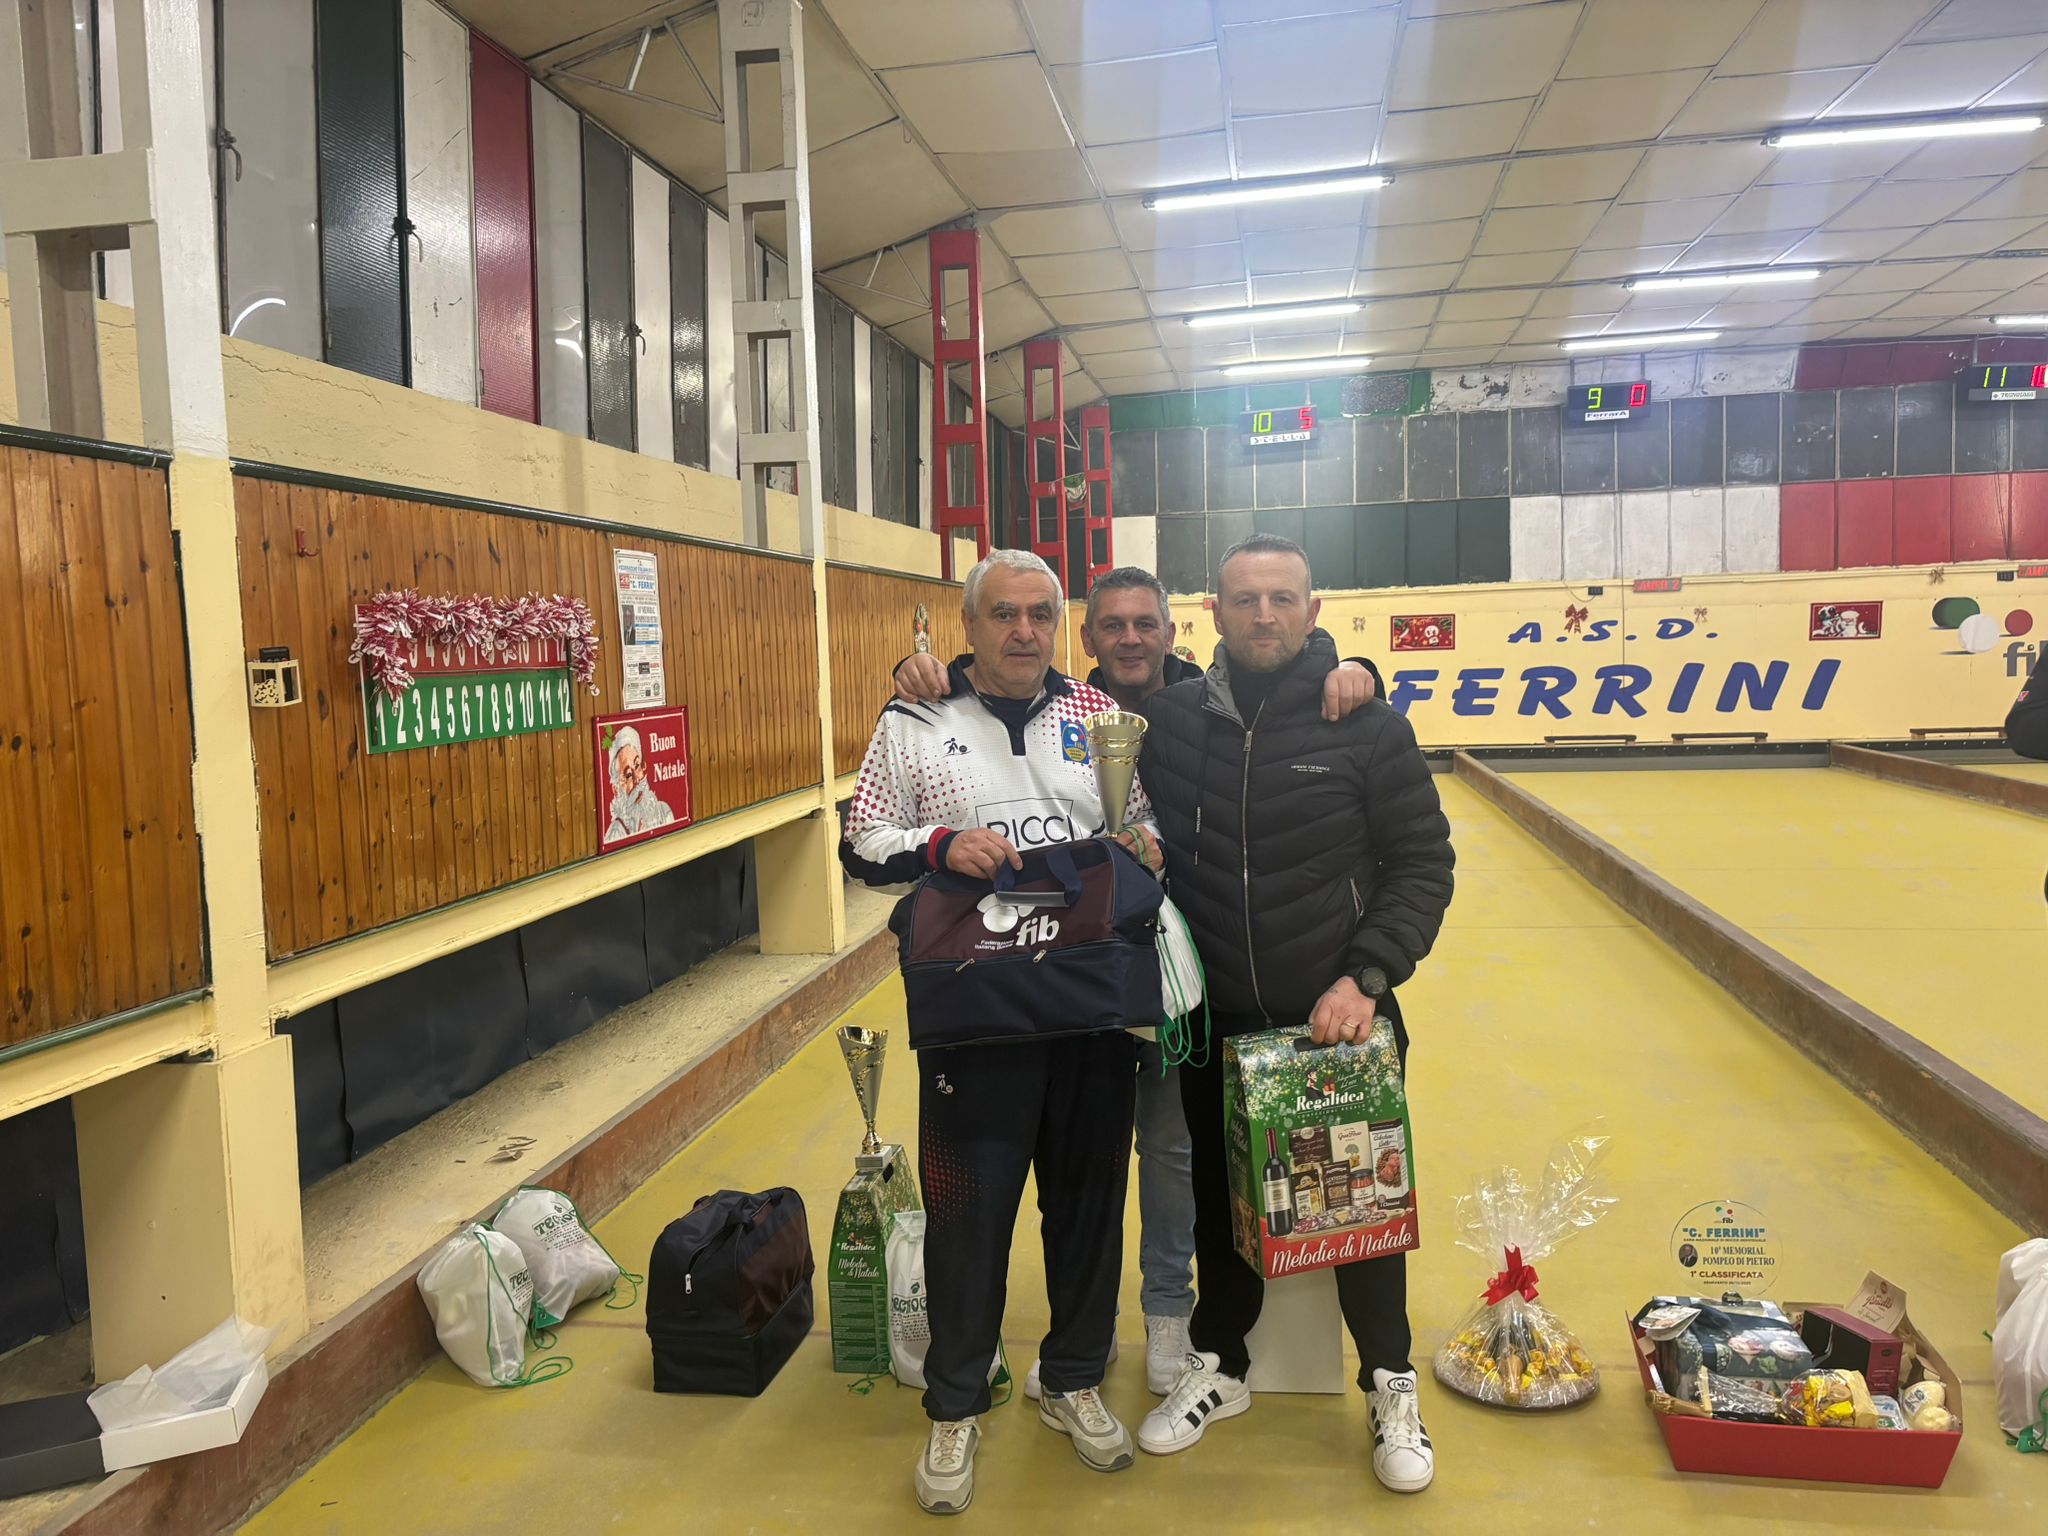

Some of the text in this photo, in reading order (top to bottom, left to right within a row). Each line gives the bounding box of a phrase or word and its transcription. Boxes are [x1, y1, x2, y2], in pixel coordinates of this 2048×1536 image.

[1587, 383, 1647, 409] 9 0
[1252, 407, 1313, 433] 10 5
[1507, 618, 1718, 643] A.S.D.
[1388, 659, 1841, 719] FERRINI
[376, 678, 572, 746] 1 2 3 4 5 6 7 8 9 10 11 12
[648, 732, 676, 753] Buon
[653, 759, 686, 783] Natale
[1015, 914, 1060, 946] fib
[1296, 1091, 1364, 1112] Regalidea
[1706, 1227, 1766, 1238] FERRINI"
[1271, 1222, 1413, 1275] Melodie di Natale
[1723, 1246, 1765, 1255] MEMORIAL
[1702, 1256, 1775, 1266] POMPEO DI PIETRO
[1699, 1270, 1764, 1279] CLASSIFICATA
